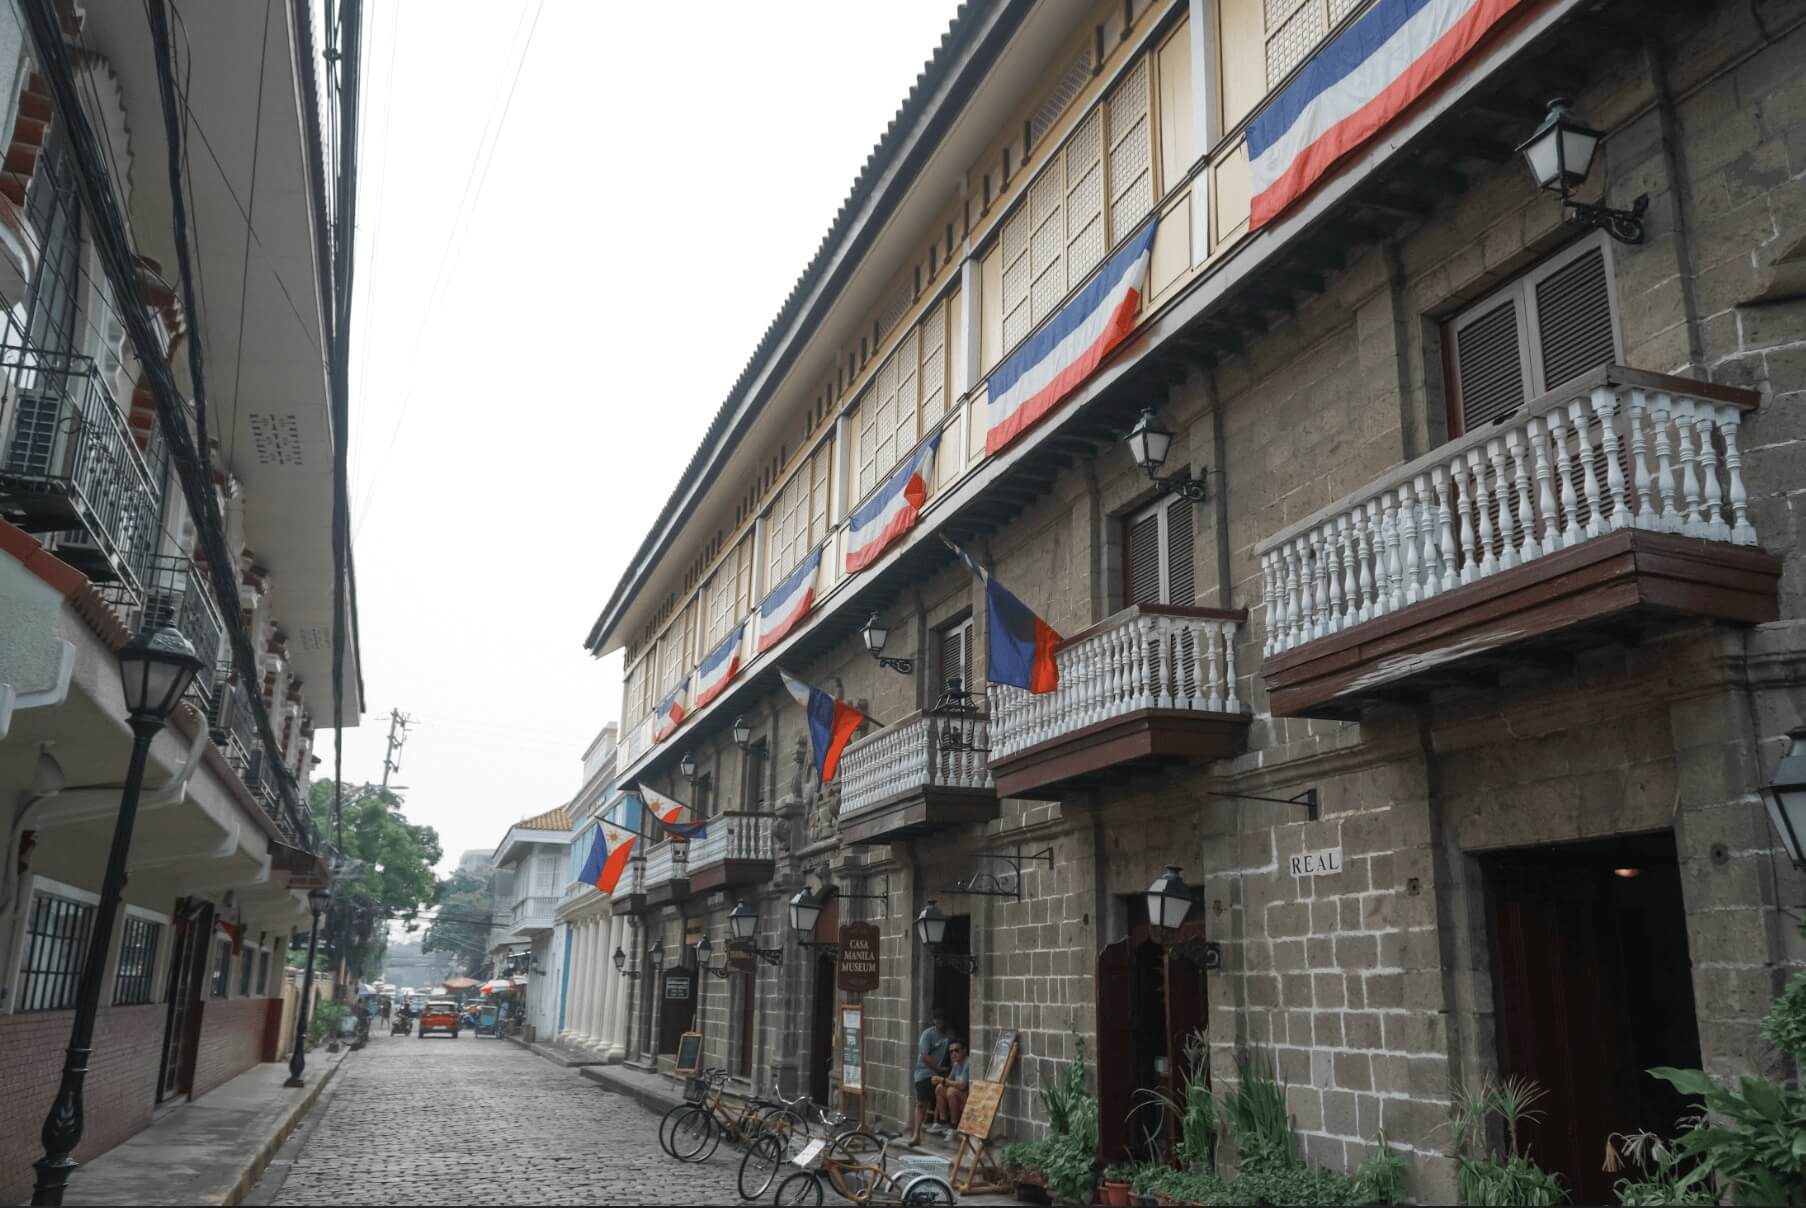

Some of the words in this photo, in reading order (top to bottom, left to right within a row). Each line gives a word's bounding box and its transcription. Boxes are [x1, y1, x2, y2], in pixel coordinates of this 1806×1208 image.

[1292, 852, 1339, 874] REAL
[849, 939, 869, 950] CASA
[843, 950, 875, 961] MANILA
[841, 961, 876, 972] MUSEUM
